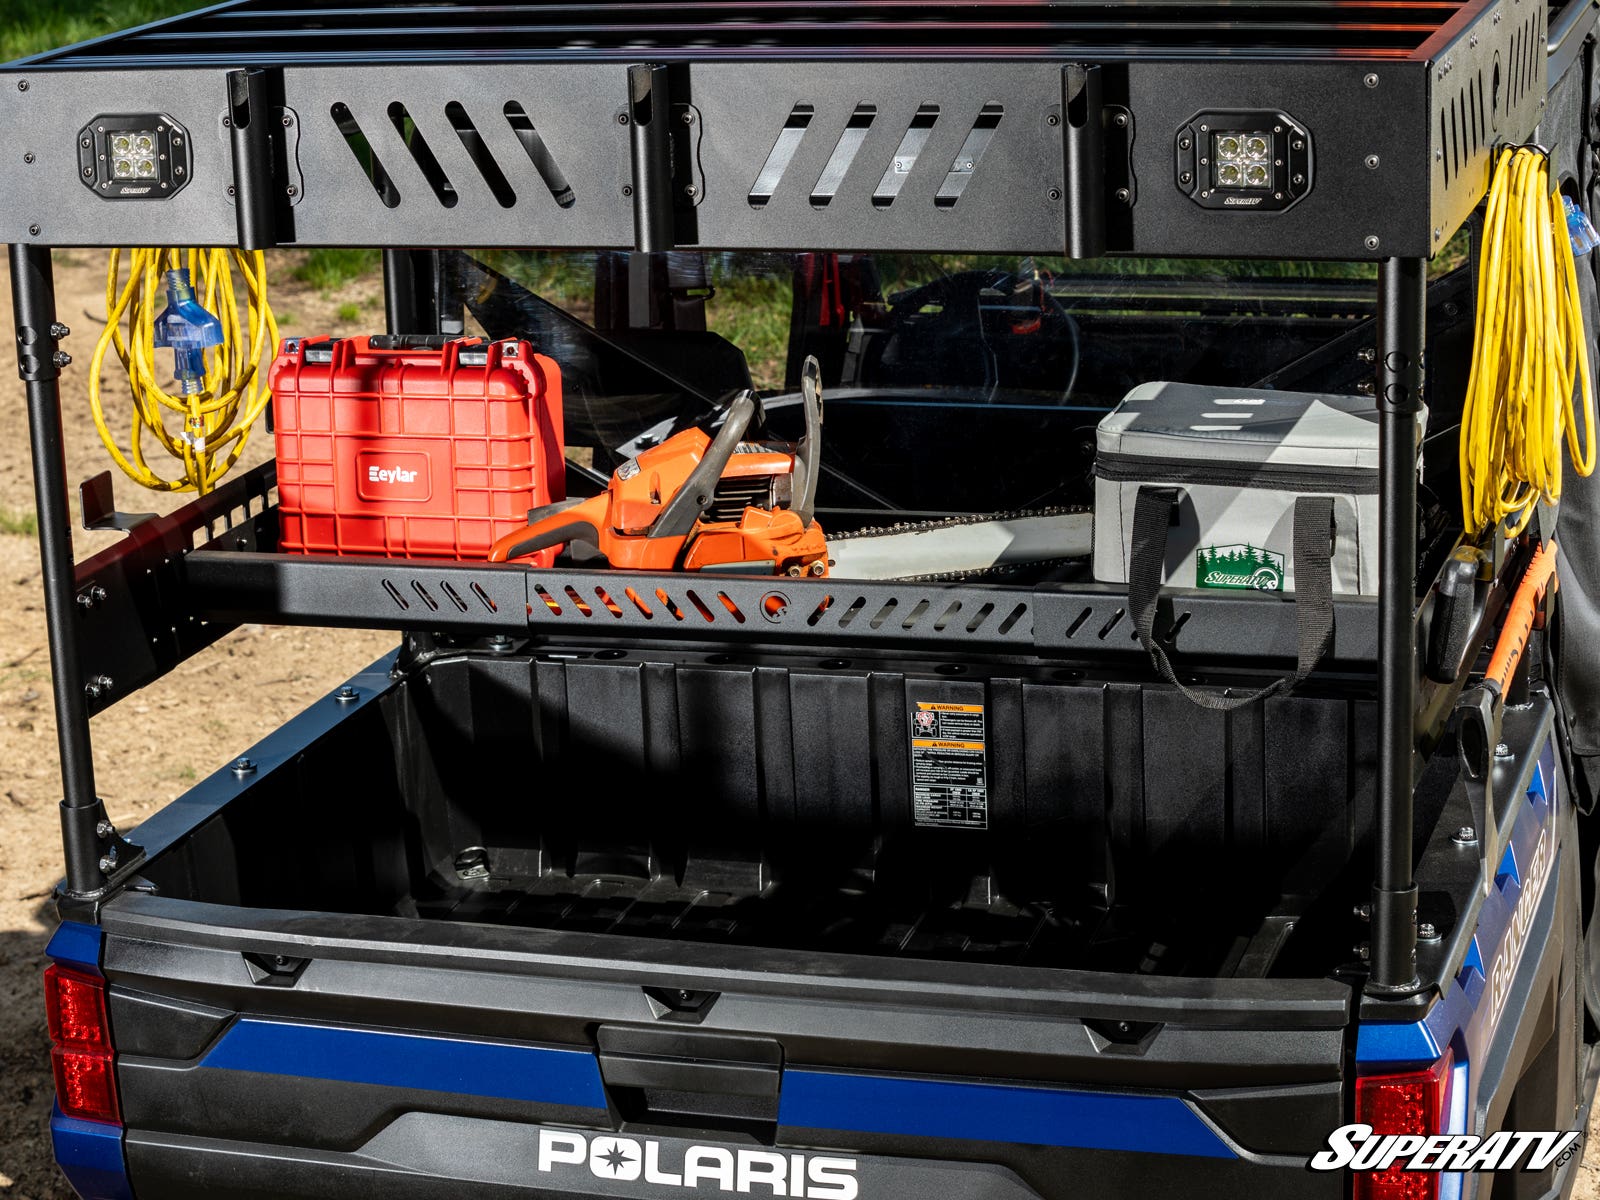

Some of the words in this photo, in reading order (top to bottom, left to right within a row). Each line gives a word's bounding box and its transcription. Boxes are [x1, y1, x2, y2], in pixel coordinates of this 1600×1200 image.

[369, 466, 418, 484] Eeylar
[1490, 829, 1547, 1027] RANGER
[538, 1129, 859, 1200] POLARIS
